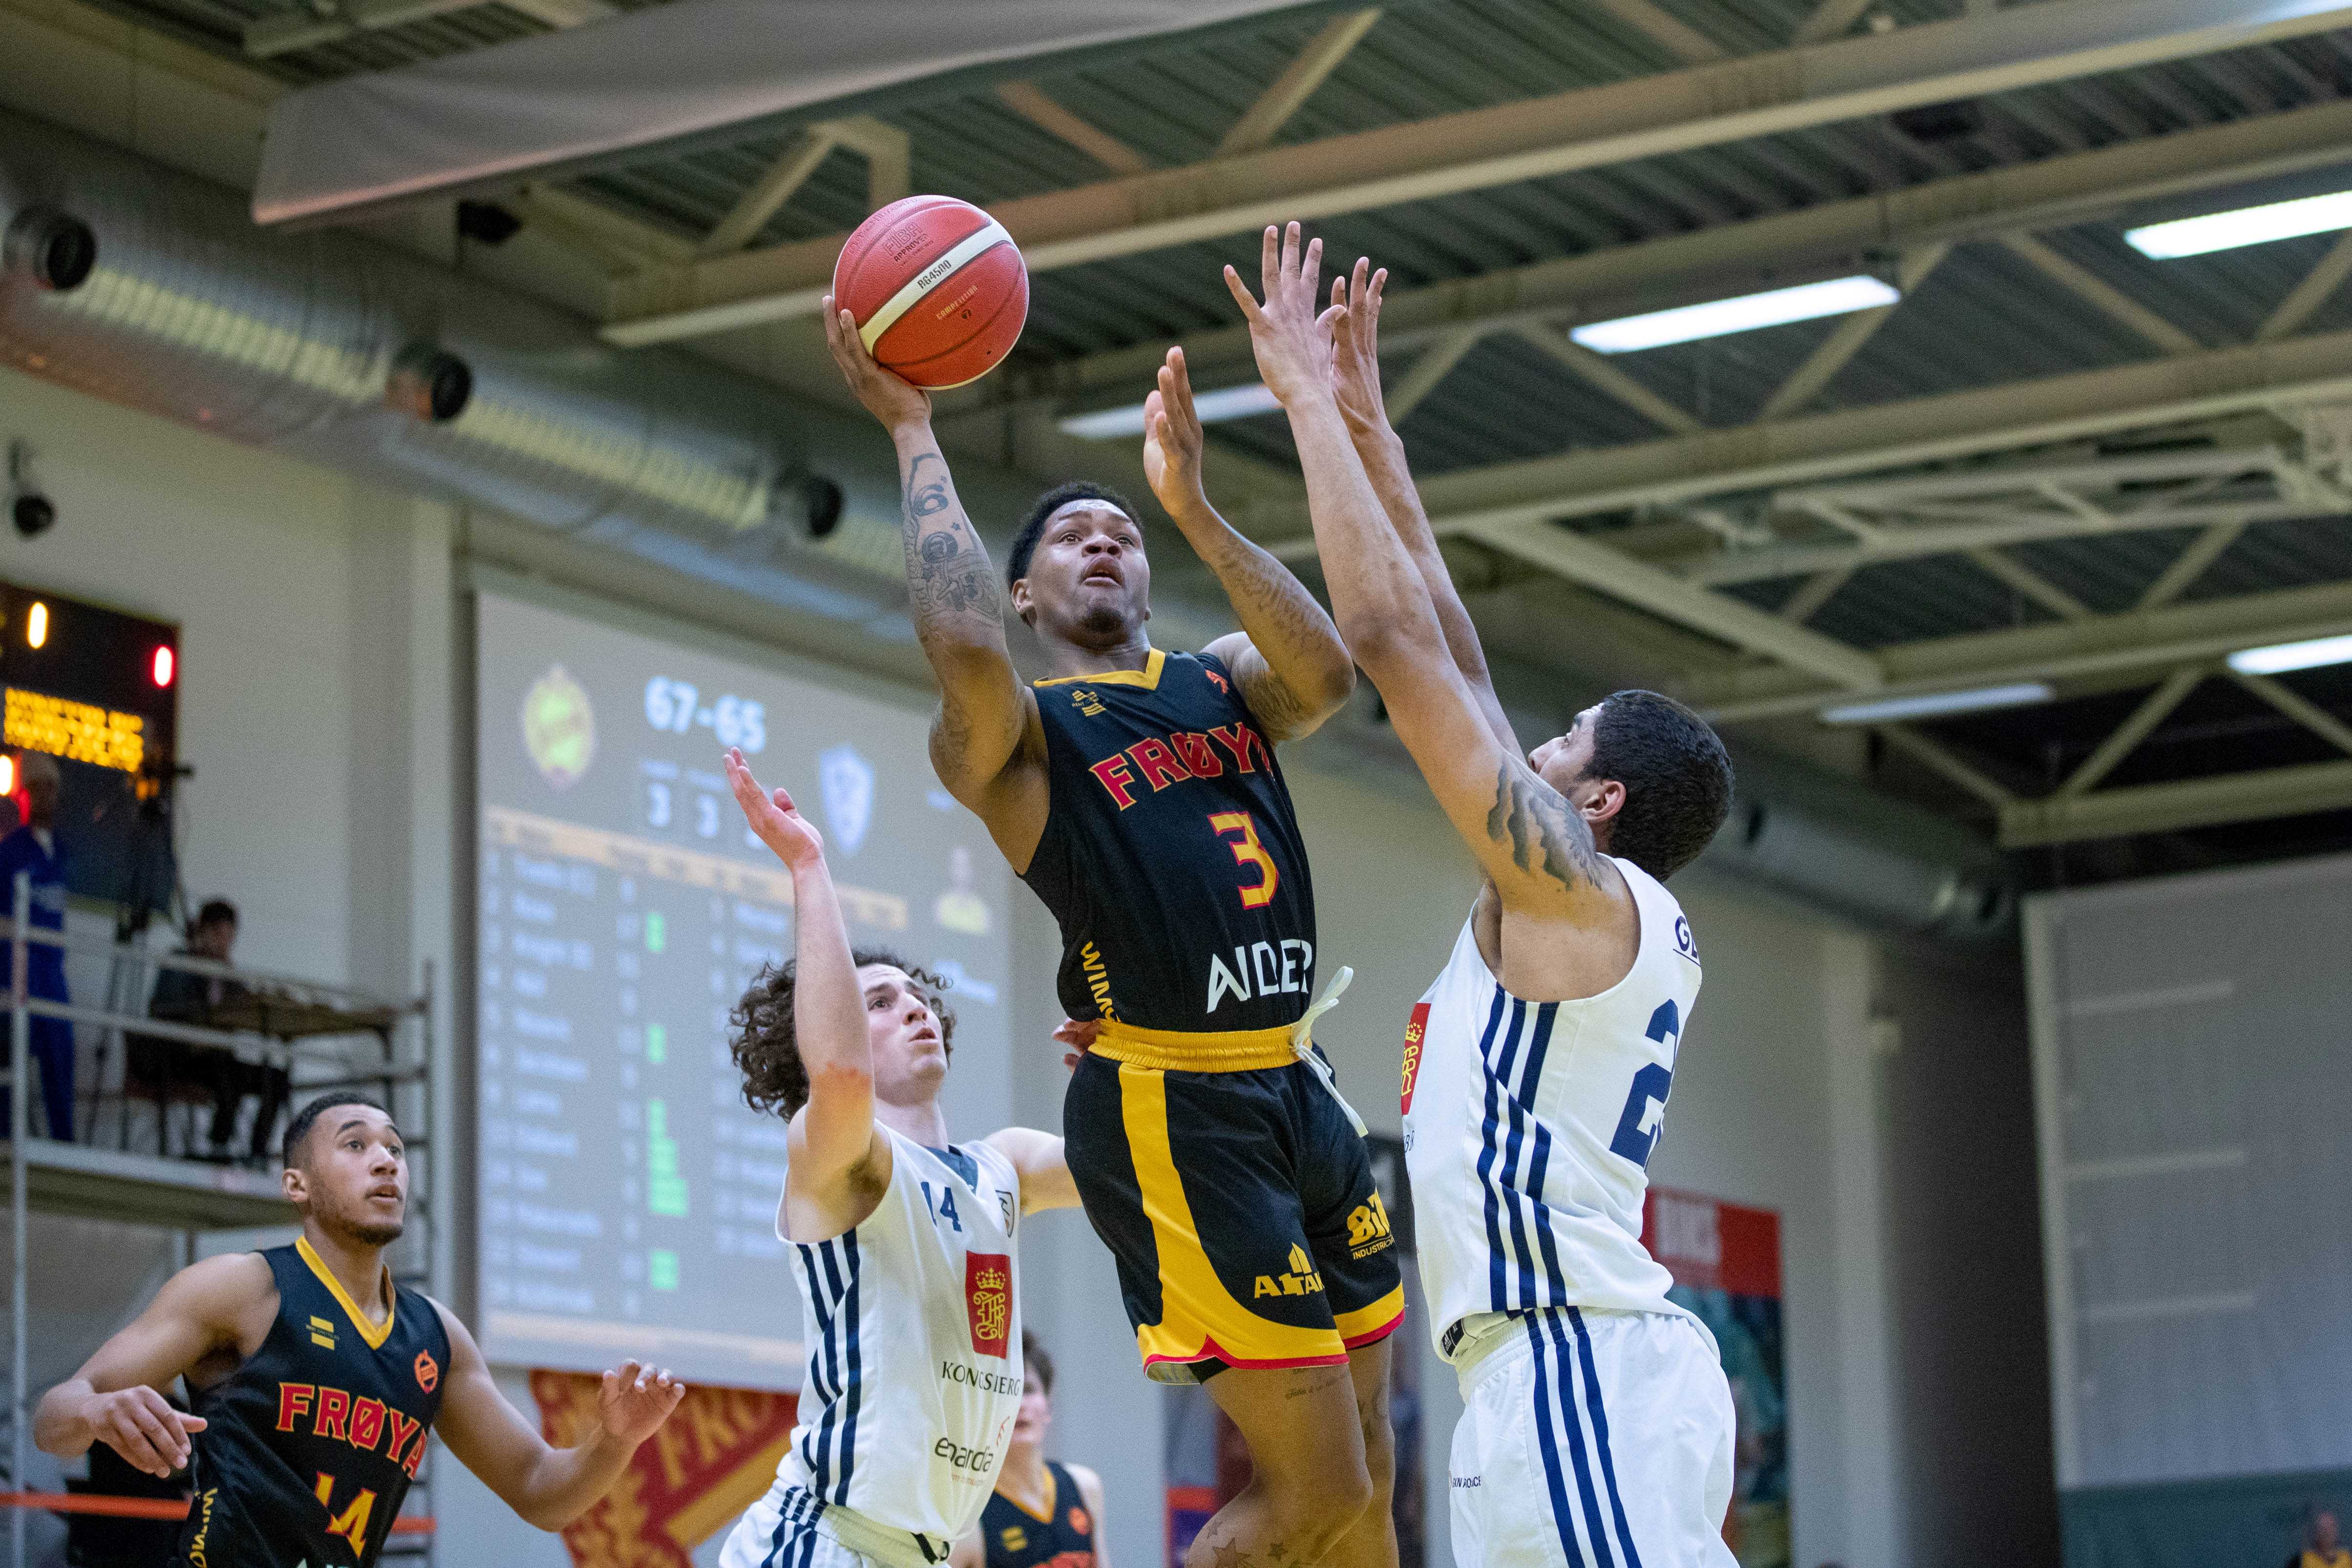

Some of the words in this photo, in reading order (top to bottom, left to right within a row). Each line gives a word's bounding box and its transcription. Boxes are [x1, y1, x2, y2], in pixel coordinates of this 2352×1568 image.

[882, 222, 923, 256] FIBA
[917, 259, 952, 289] RG4500
[645, 676, 768, 753] 67-65
[1207, 810, 1280, 911] 3
[275, 1382, 427, 1481] FRØYA
